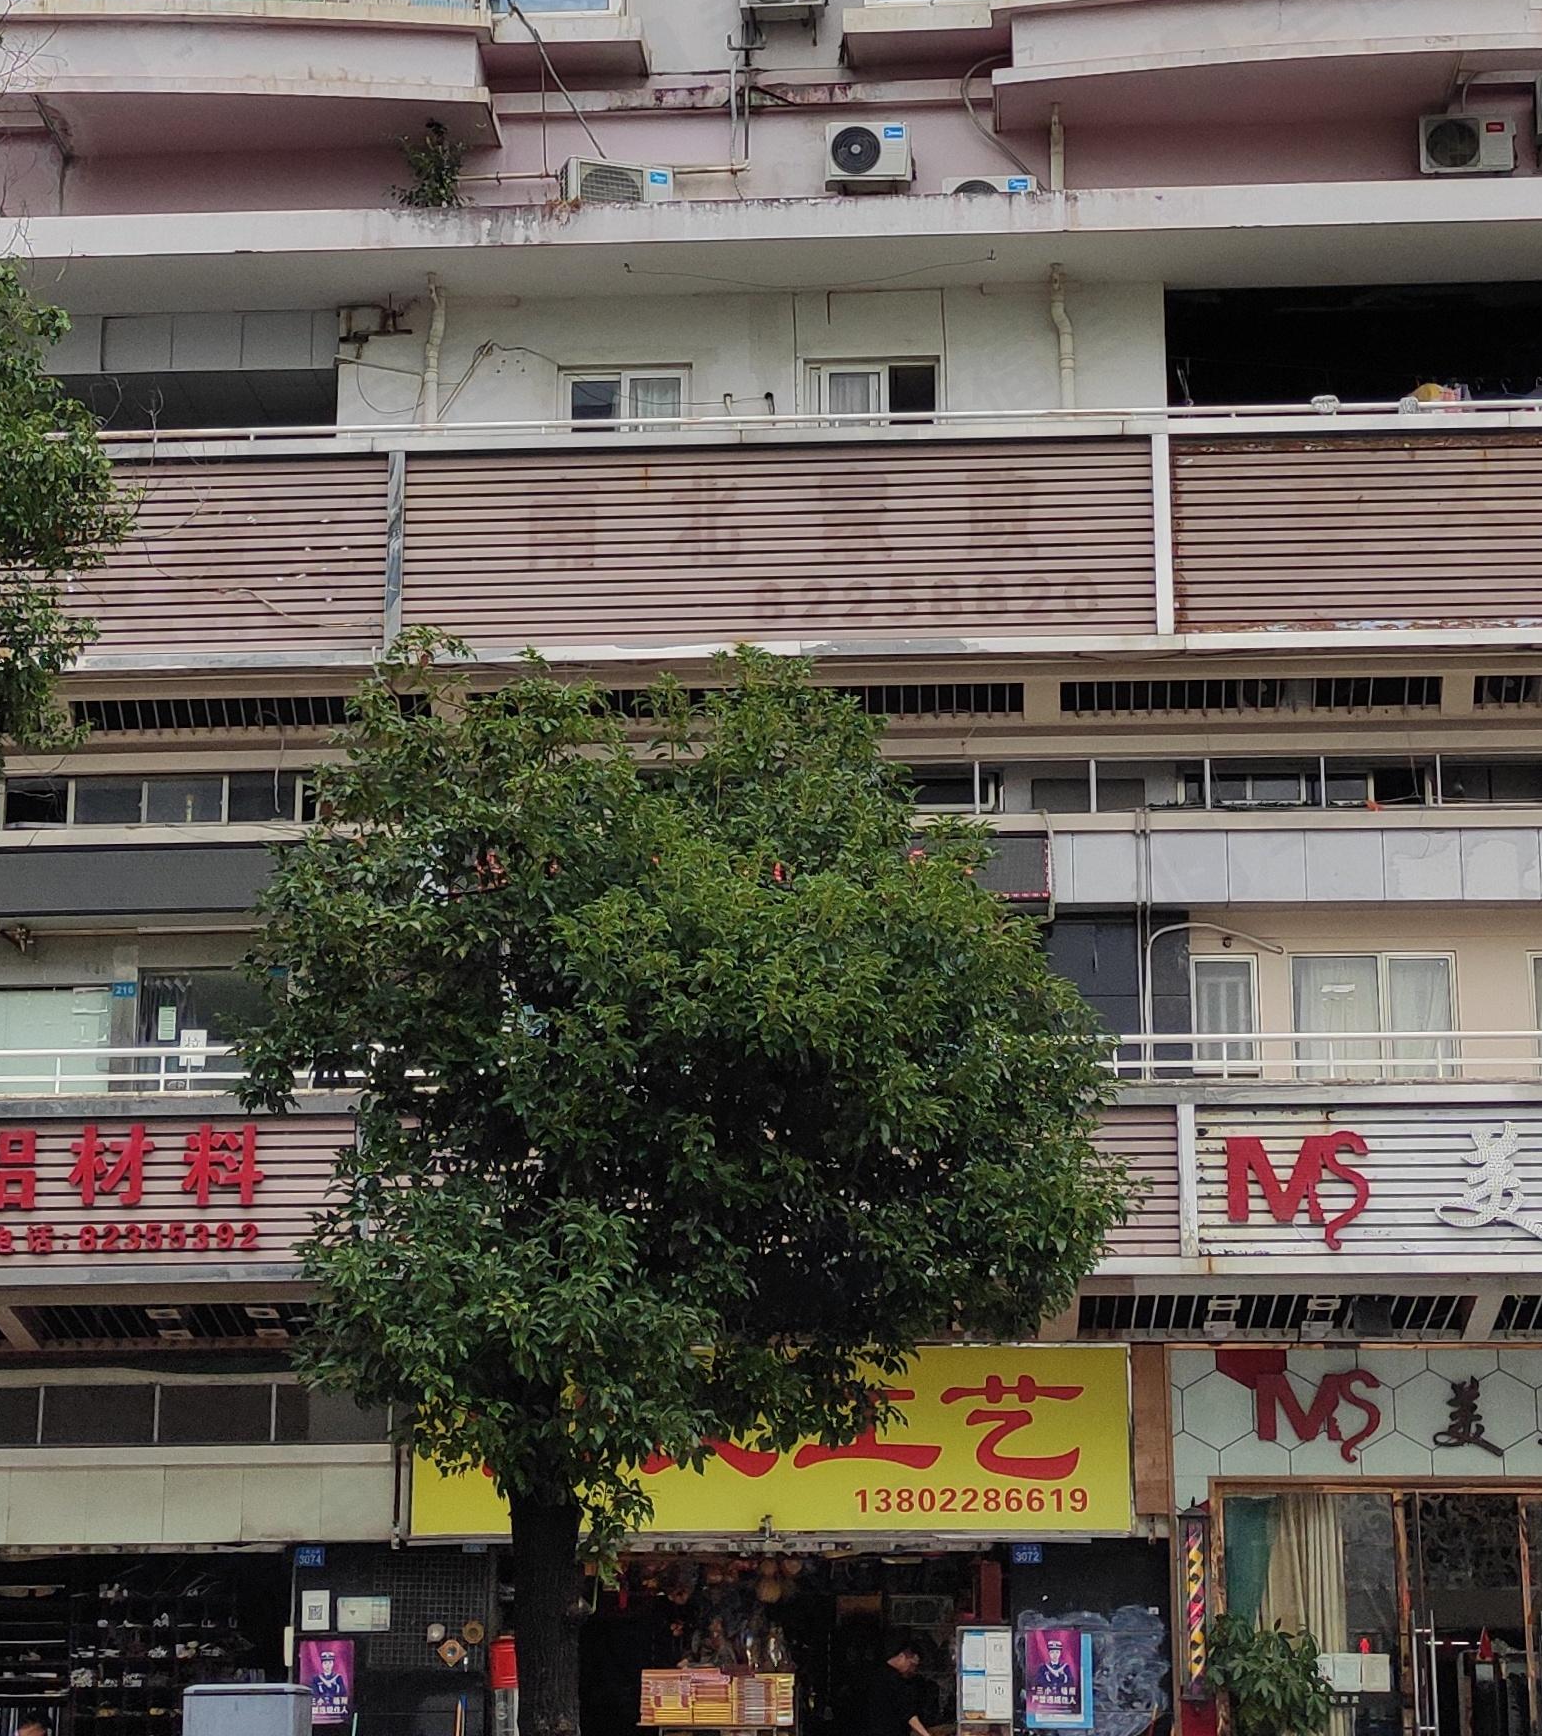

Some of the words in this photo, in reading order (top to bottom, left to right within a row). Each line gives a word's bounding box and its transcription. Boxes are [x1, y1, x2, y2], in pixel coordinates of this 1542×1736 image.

[1224, 1130, 1369, 1251] MS
[1257, 1368, 1382, 1463] MS
[853, 1486, 1090, 1515] 13802286619
